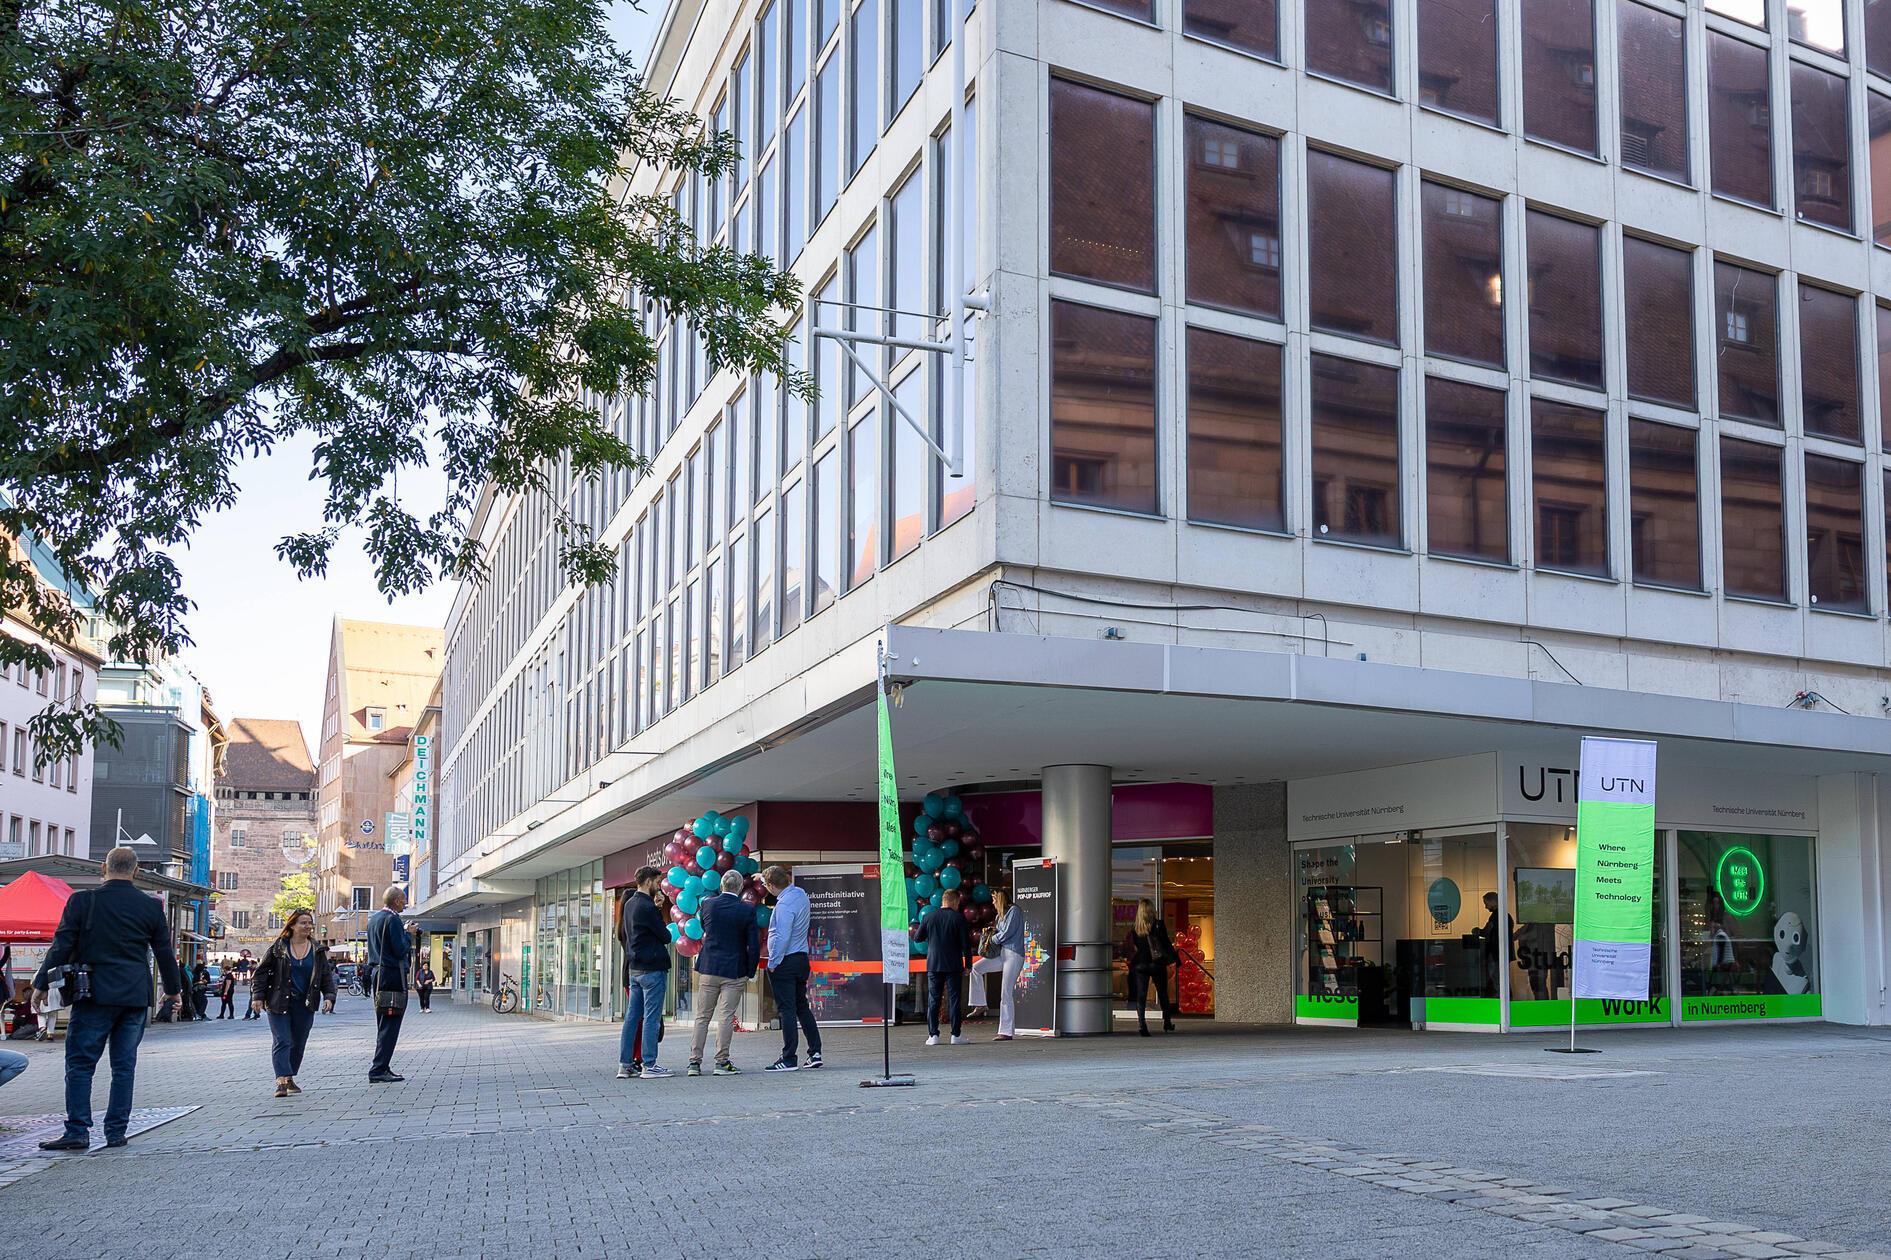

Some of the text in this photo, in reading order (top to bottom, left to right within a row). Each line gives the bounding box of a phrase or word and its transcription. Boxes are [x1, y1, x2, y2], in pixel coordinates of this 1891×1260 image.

[415, 736, 428, 839] DEICHMANN
[1601, 776, 1644, 793] UTN
[1302, 804, 1404, 822] Technische Universität Nürnberg
[1712, 805, 1745, 815] Technische
[1777, 809, 1805, 819] Nürnberg
[388, 813, 409, 839] seitz
[1598, 843, 1626, 852] Where
[1301, 857, 1338, 870] Shape the
[1597, 860, 1639, 870] Nürnberg
[1301, 876, 1338, 886] University
[1596, 876, 1622, 885] Meets
[1595, 892, 1642, 903] Technology
[810, 900, 841, 909] nenstadt
[1687, 1000, 1767, 1016] in Nuremberg
